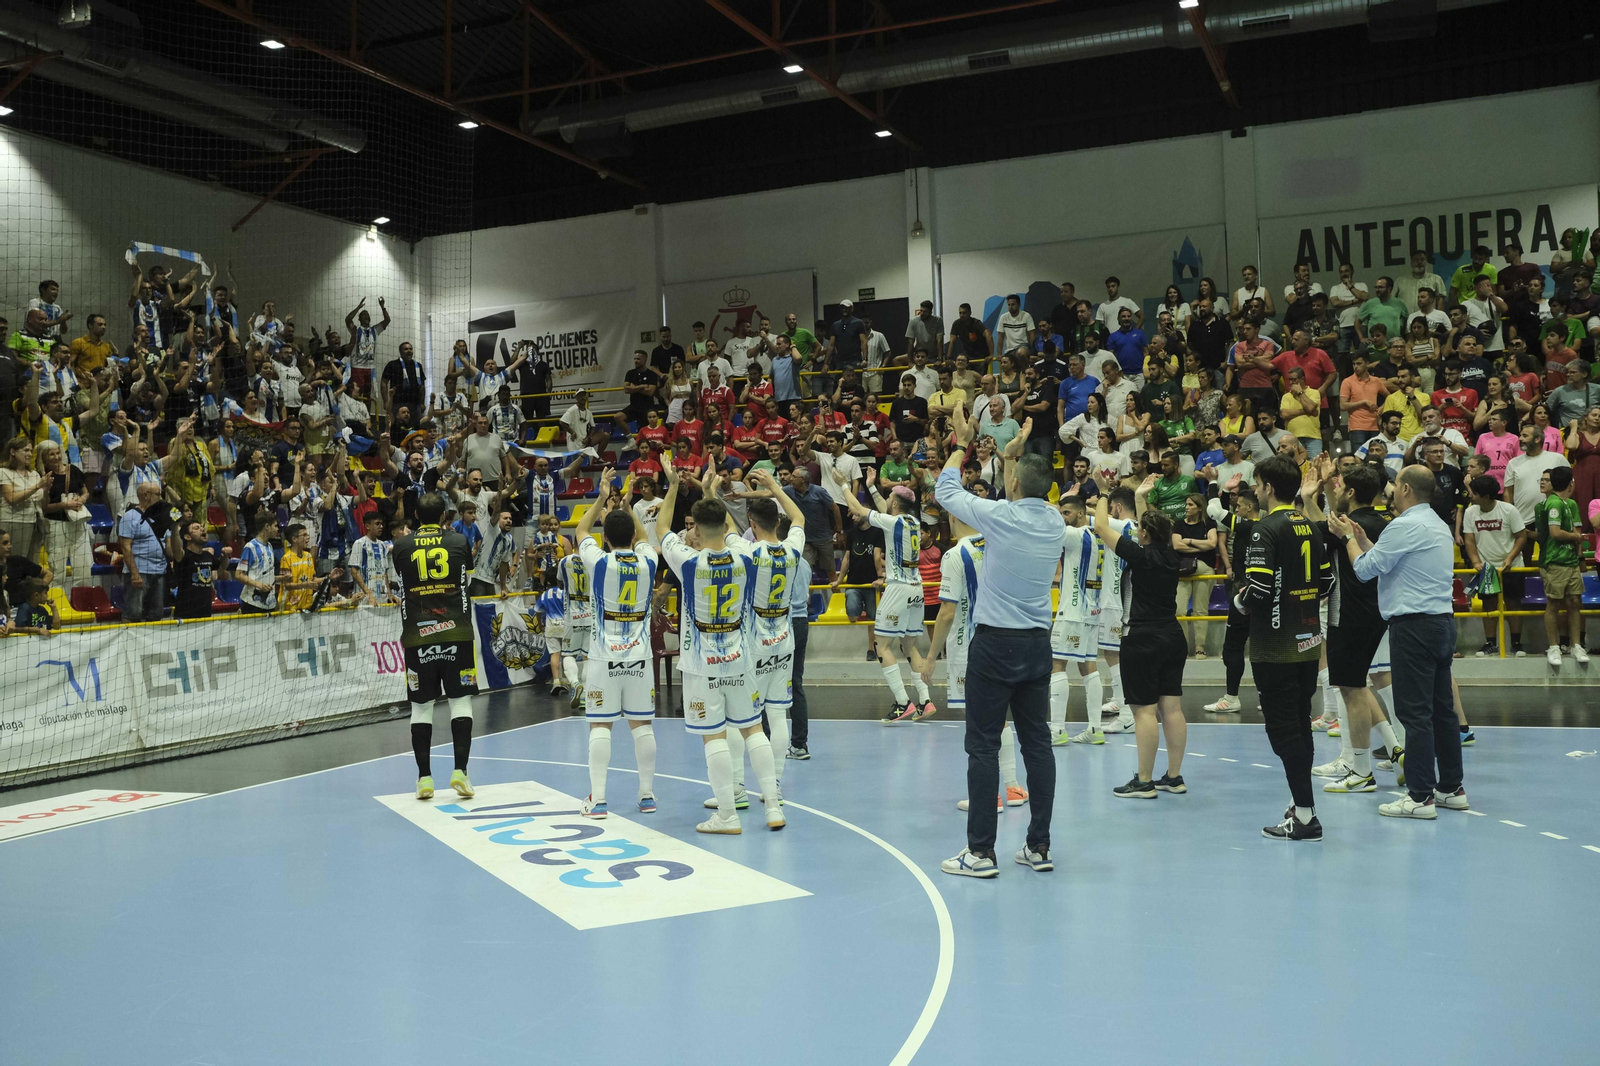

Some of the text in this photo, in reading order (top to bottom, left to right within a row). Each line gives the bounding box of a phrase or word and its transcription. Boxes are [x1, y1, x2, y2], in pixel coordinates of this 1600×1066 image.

[1295, 203, 1560, 273] ANTEQUERA
[537, 329, 598, 350] DÓLMENES
[1293, 524, 1313, 536] VARA
[413, 536, 443, 546] TOMY
[411, 547, 450, 582] 13
[617, 565, 641, 575] FRAN
[1301, 540, 1311, 583] 1
[696, 568, 729, 580] BRIAN
[617, 580, 638, 608] 4
[768, 573, 787, 605] 2
[702, 582, 741, 619] 12
[1271, 603, 1281, 630] CAJA
[419, 620, 455, 636] MACIAS
[419, 654, 457, 664] BUSANAUTO
[706, 650, 741, 666] MACIAS
[0, 720, 24, 731] laga
[39, 704, 128, 726] diputación de málaga
